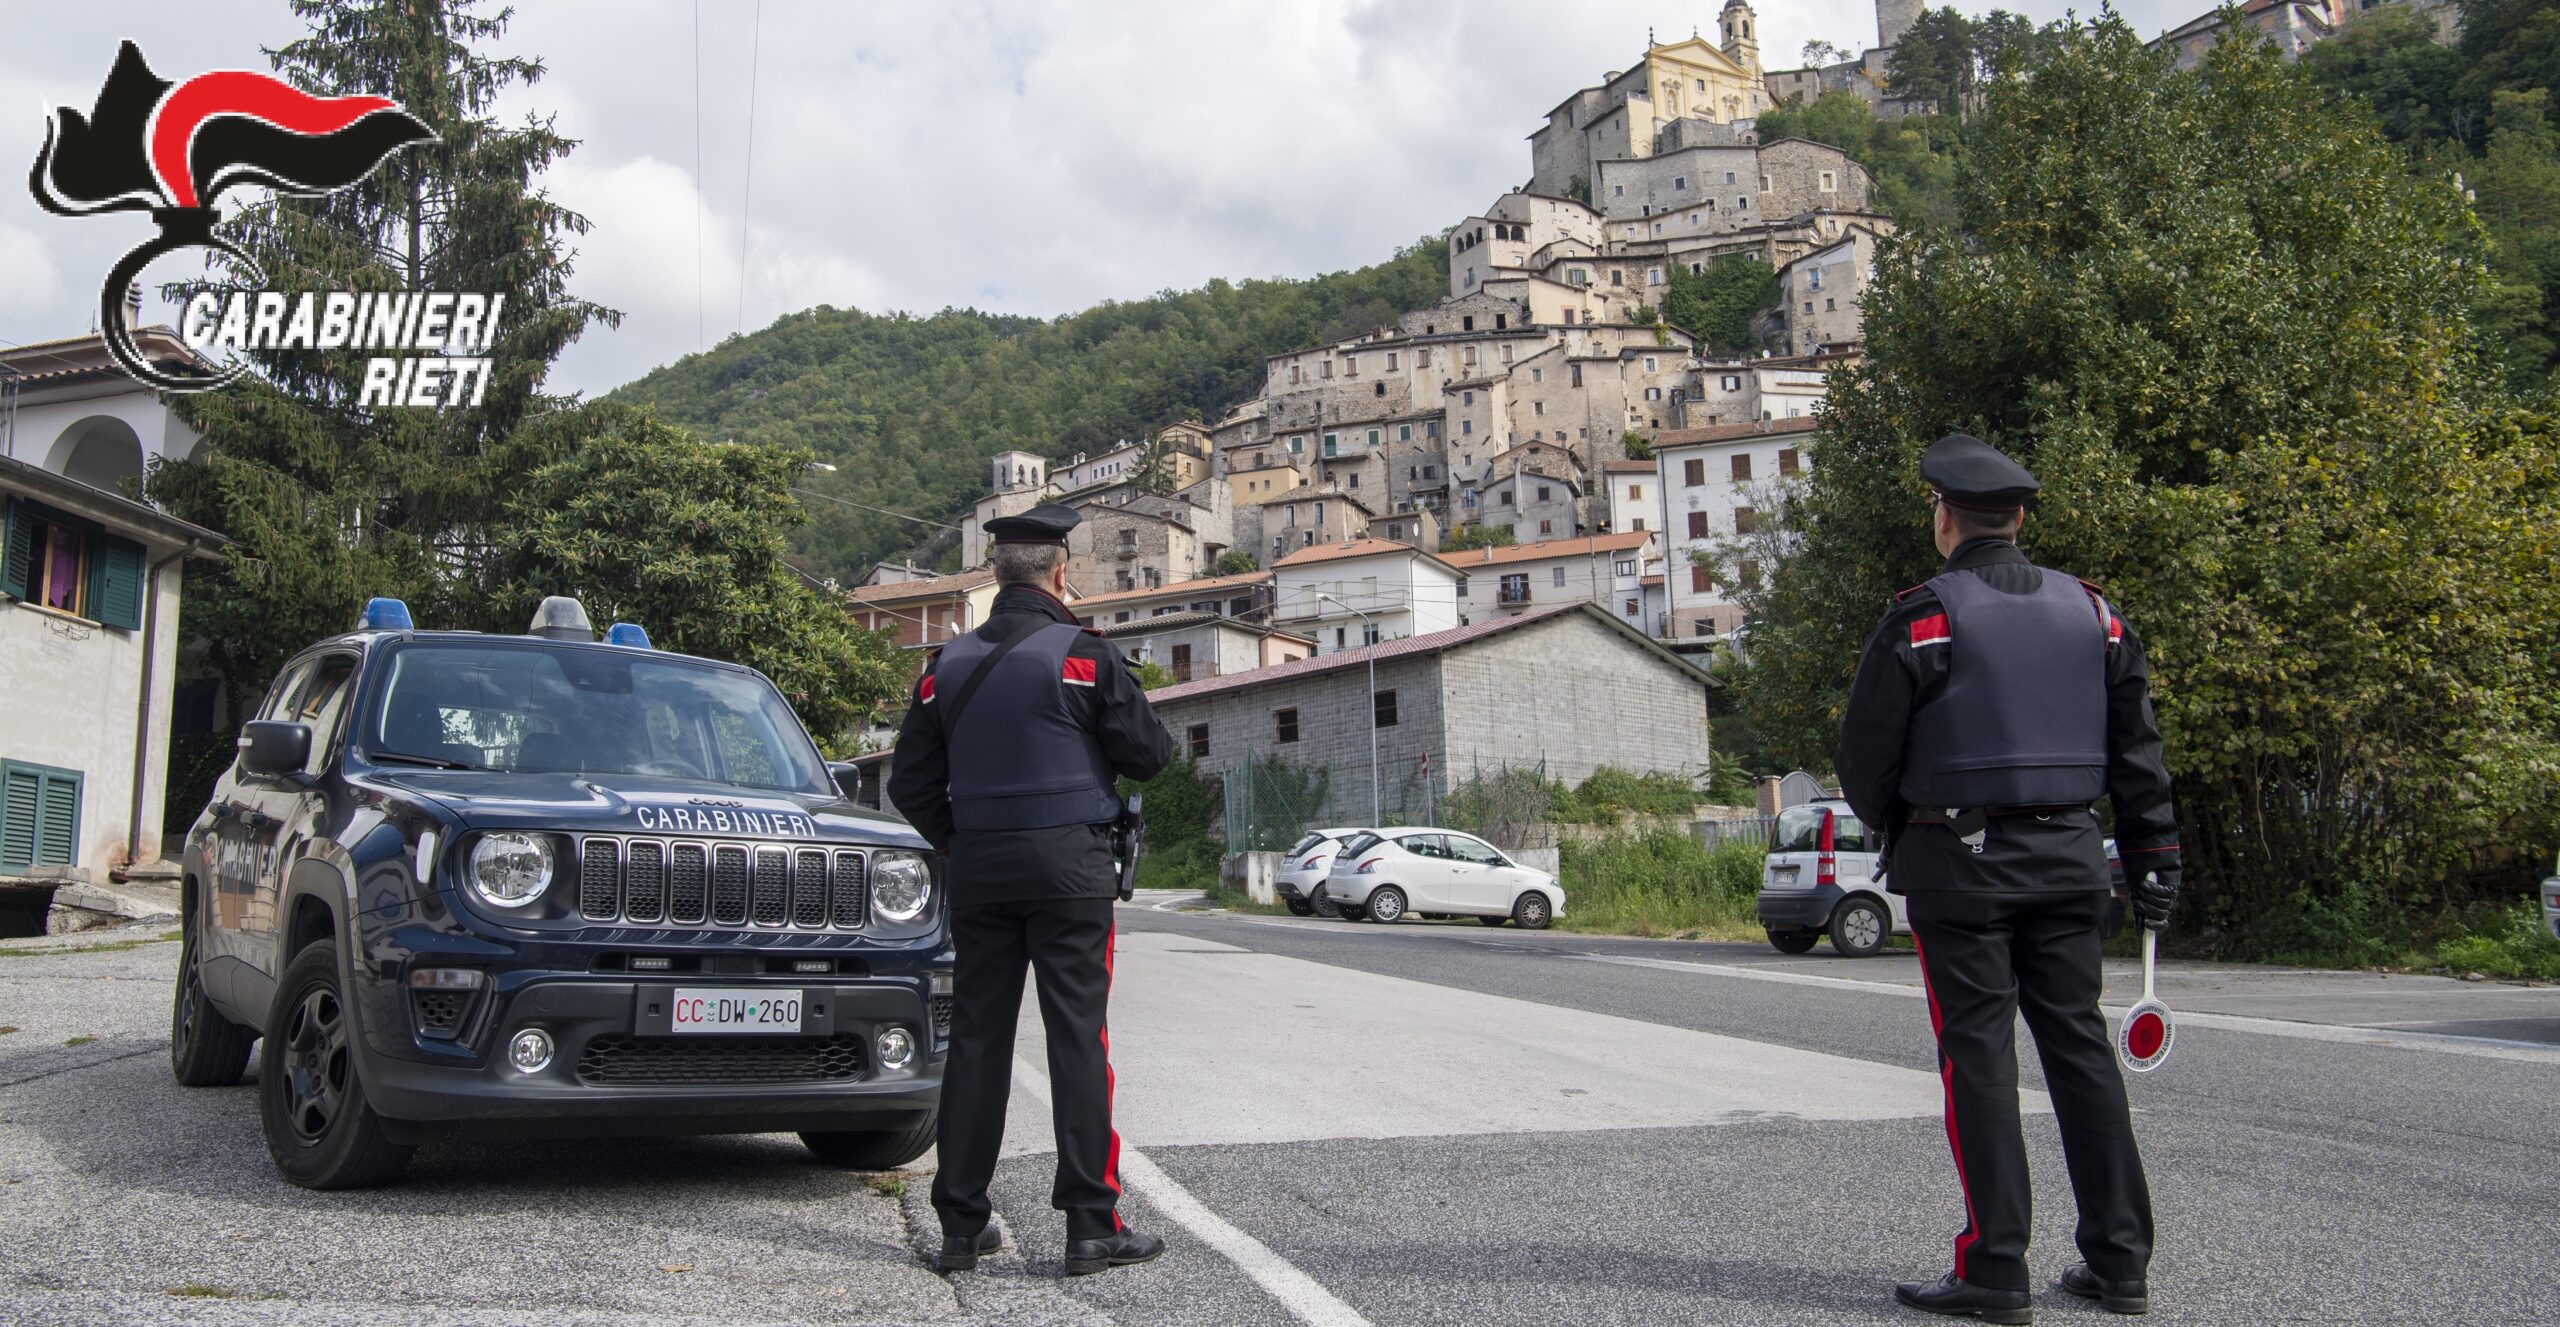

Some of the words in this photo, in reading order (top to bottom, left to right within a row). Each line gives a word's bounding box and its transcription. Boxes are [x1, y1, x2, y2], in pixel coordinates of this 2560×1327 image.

[637, 806, 815, 837] CARABINIERI
[2120, 1029, 2131, 1058] DIFESA
[2150, 1023, 2172, 1064] MINISTERO
[2128, 1055, 2149, 1067] DELLA
